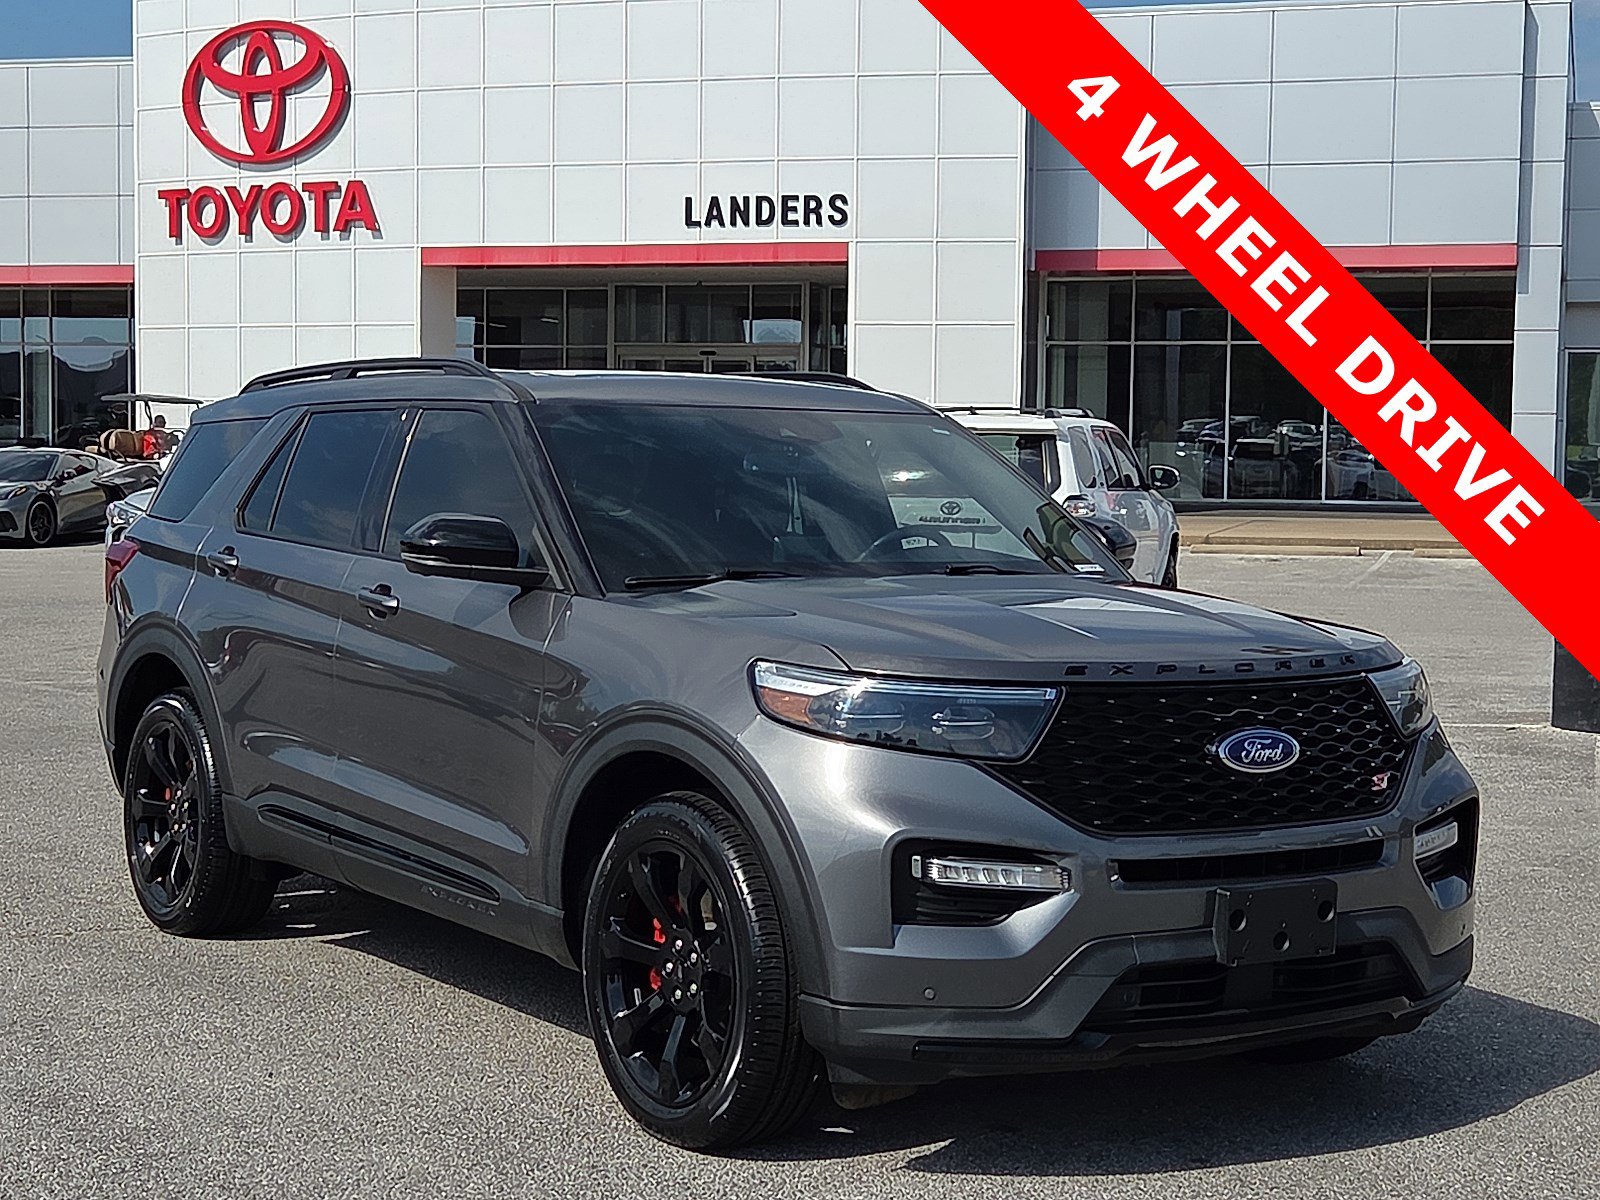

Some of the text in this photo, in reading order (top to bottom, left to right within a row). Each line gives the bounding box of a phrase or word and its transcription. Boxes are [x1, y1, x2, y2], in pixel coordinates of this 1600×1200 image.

[158, 180, 381, 240] TOYOTA
[684, 193, 849, 228] LANDERS
[1064, 654, 1356, 677] EXPLORER
[1241, 738, 1284, 763] Ford
